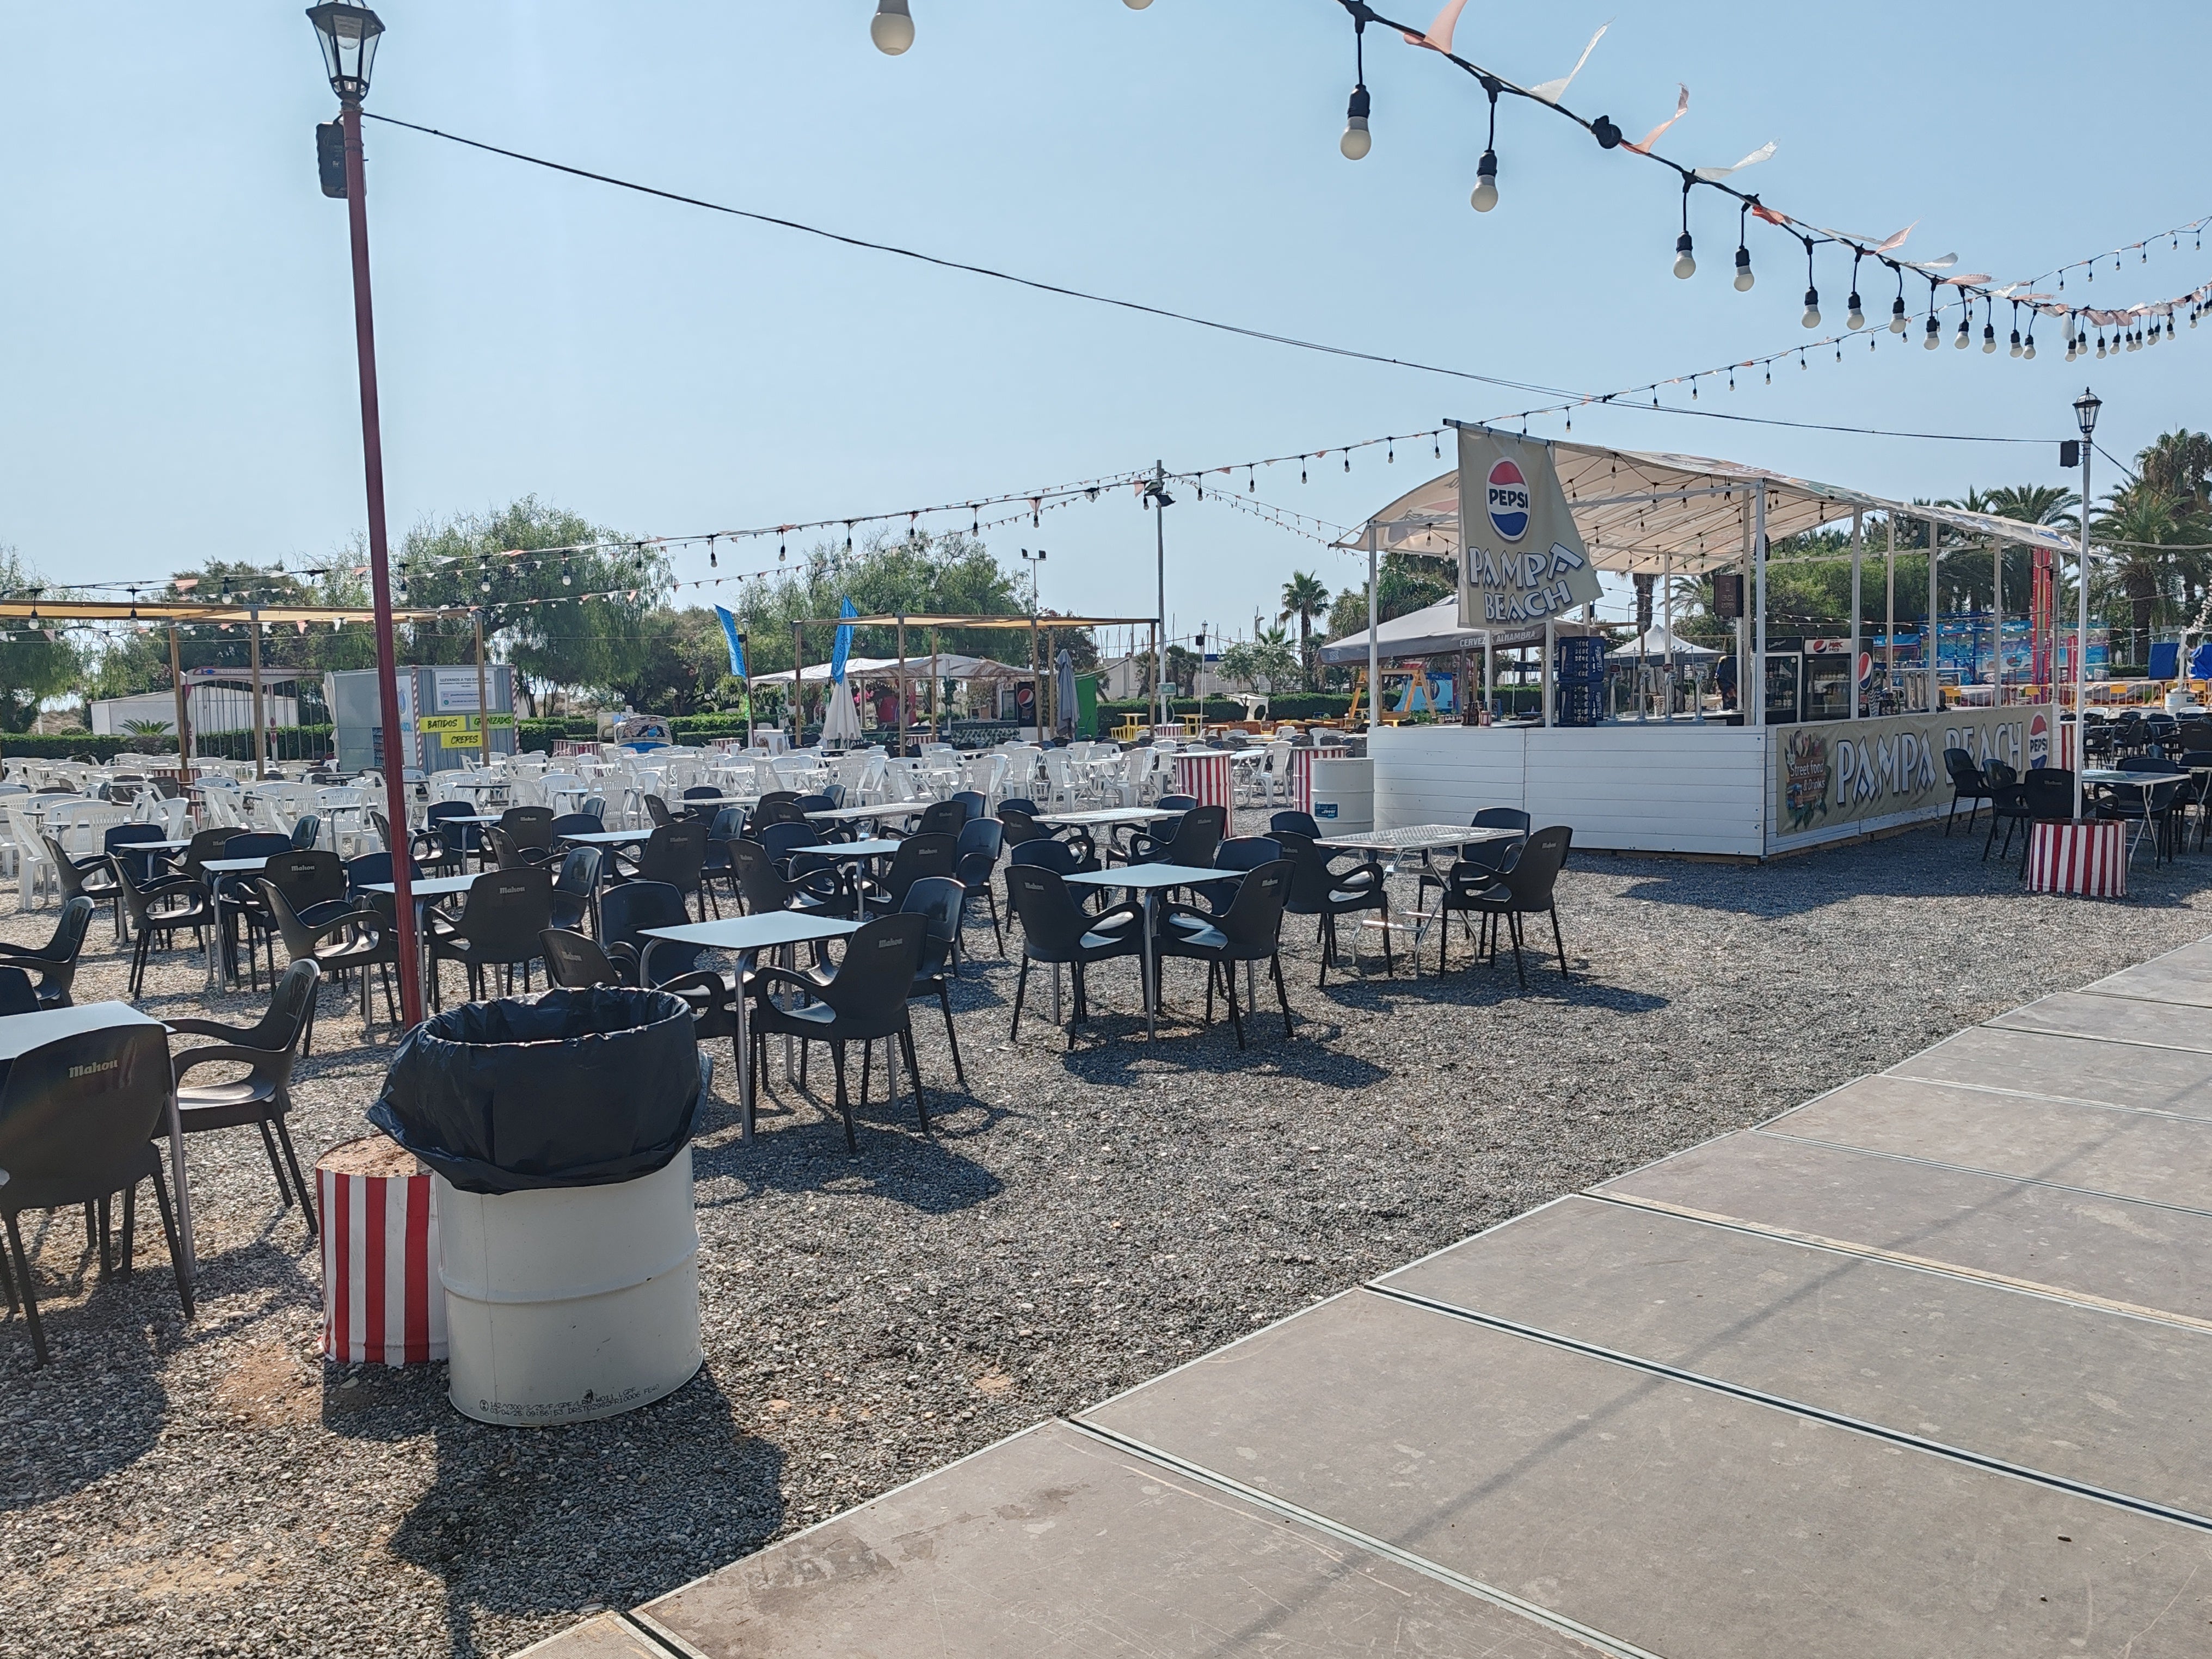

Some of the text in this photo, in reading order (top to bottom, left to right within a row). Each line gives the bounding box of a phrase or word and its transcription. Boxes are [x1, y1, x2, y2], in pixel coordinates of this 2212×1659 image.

[1489, 489, 1528, 509] PEPSI
[1468, 543, 1584, 588] PAMPA
[1484, 580, 1572, 621] BEACH
[1460, 631, 1535, 647] CERVEZS ALHAMBRA
[428, 716, 512, 729] BATIDOS GNIZADOS
[451, 735, 478, 744] CREPES
[2030, 738, 2048, 753] PEPSI
[1790, 759, 1824, 777] Street food
[1836, 729, 1937, 804] PAMPA
[1808, 777, 1825, 789] Drinks
[500, 886, 525, 894] Mahou
[1024, 882, 1044, 890] Mahou
[878, 938, 902, 948] Mahou
[69, 1059, 118, 1078] Mahou
